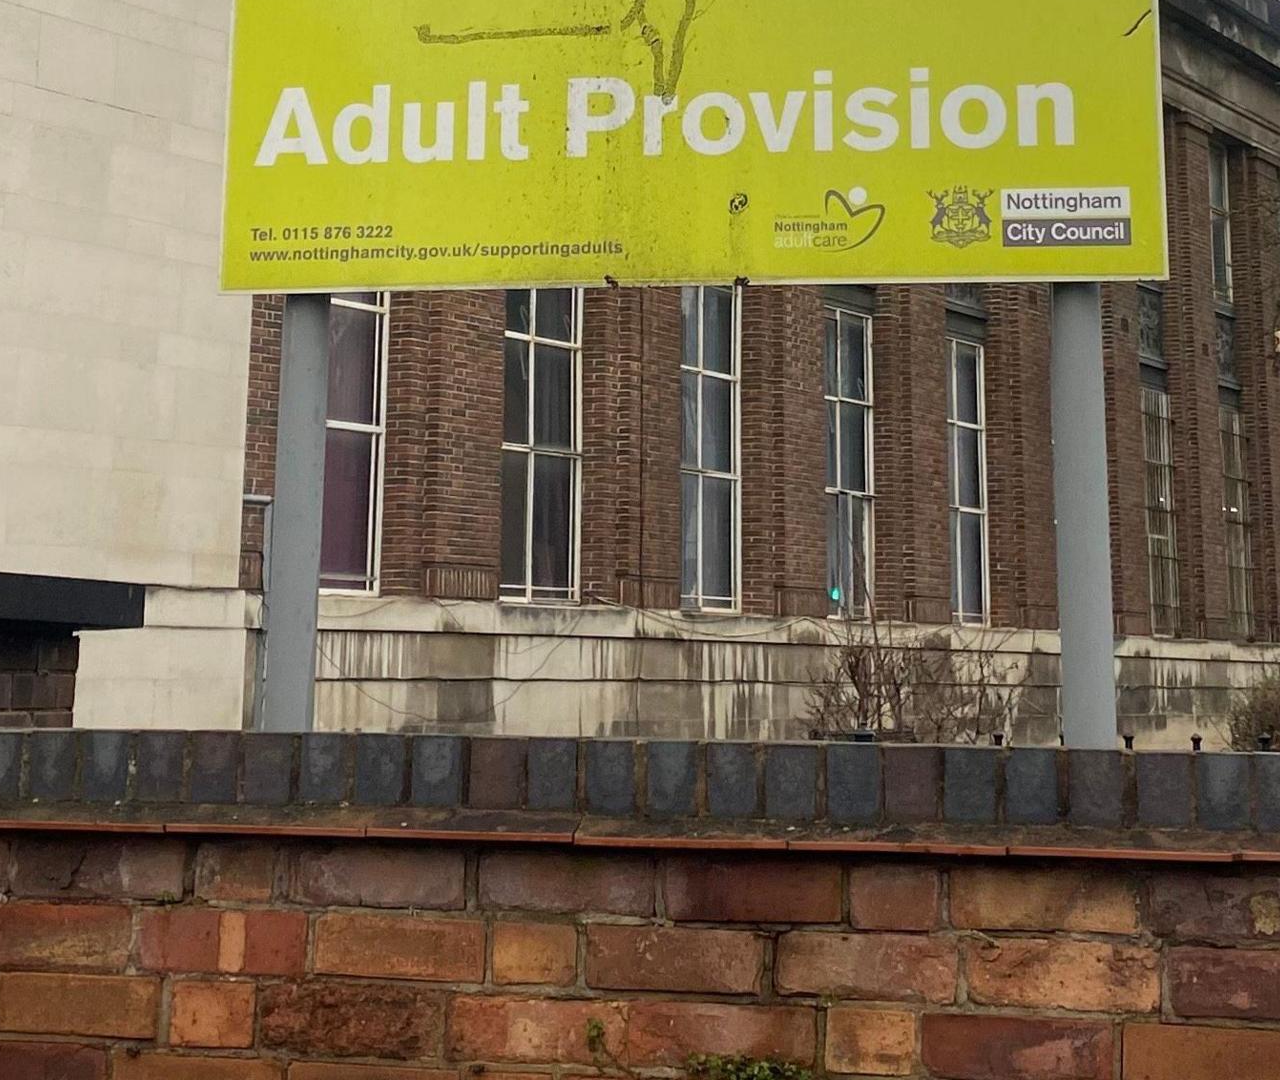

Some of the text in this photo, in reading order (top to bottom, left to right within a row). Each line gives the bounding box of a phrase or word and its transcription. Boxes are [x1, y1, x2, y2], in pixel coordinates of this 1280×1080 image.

[254, 67, 1077, 168] Adult Provision
[1005, 191, 1122, 213] Nottingham
[250, 225, 393, 241] Tel. 0115 876 3222
[774, 221, 848, 235] Nottingham
[1006, 221, 1125, 244] City Council
[249, 240, 624, 263] www.nottinghamcity.gov.uk/supportingadults
